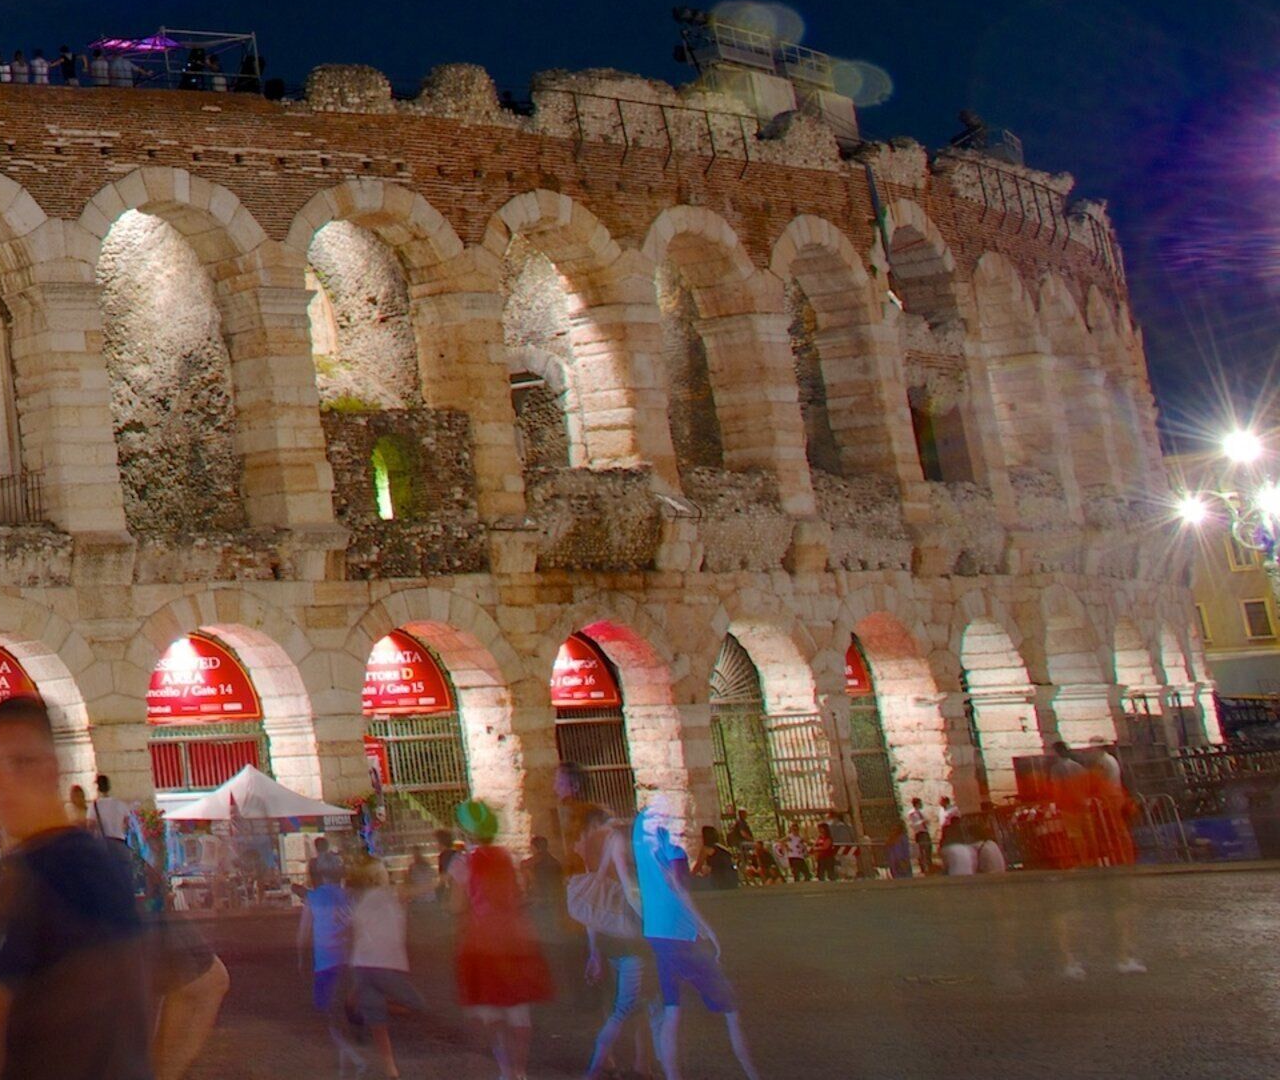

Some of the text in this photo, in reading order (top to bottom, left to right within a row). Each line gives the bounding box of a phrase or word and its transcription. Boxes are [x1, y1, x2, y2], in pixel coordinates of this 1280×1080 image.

[401, 668, 414, 680] D
[584, 675, 595, 685] 16
[191, 685, 218, 696] Gate
[220, 684, 233, 694] 14
[411, 682, 424, 693] 15
